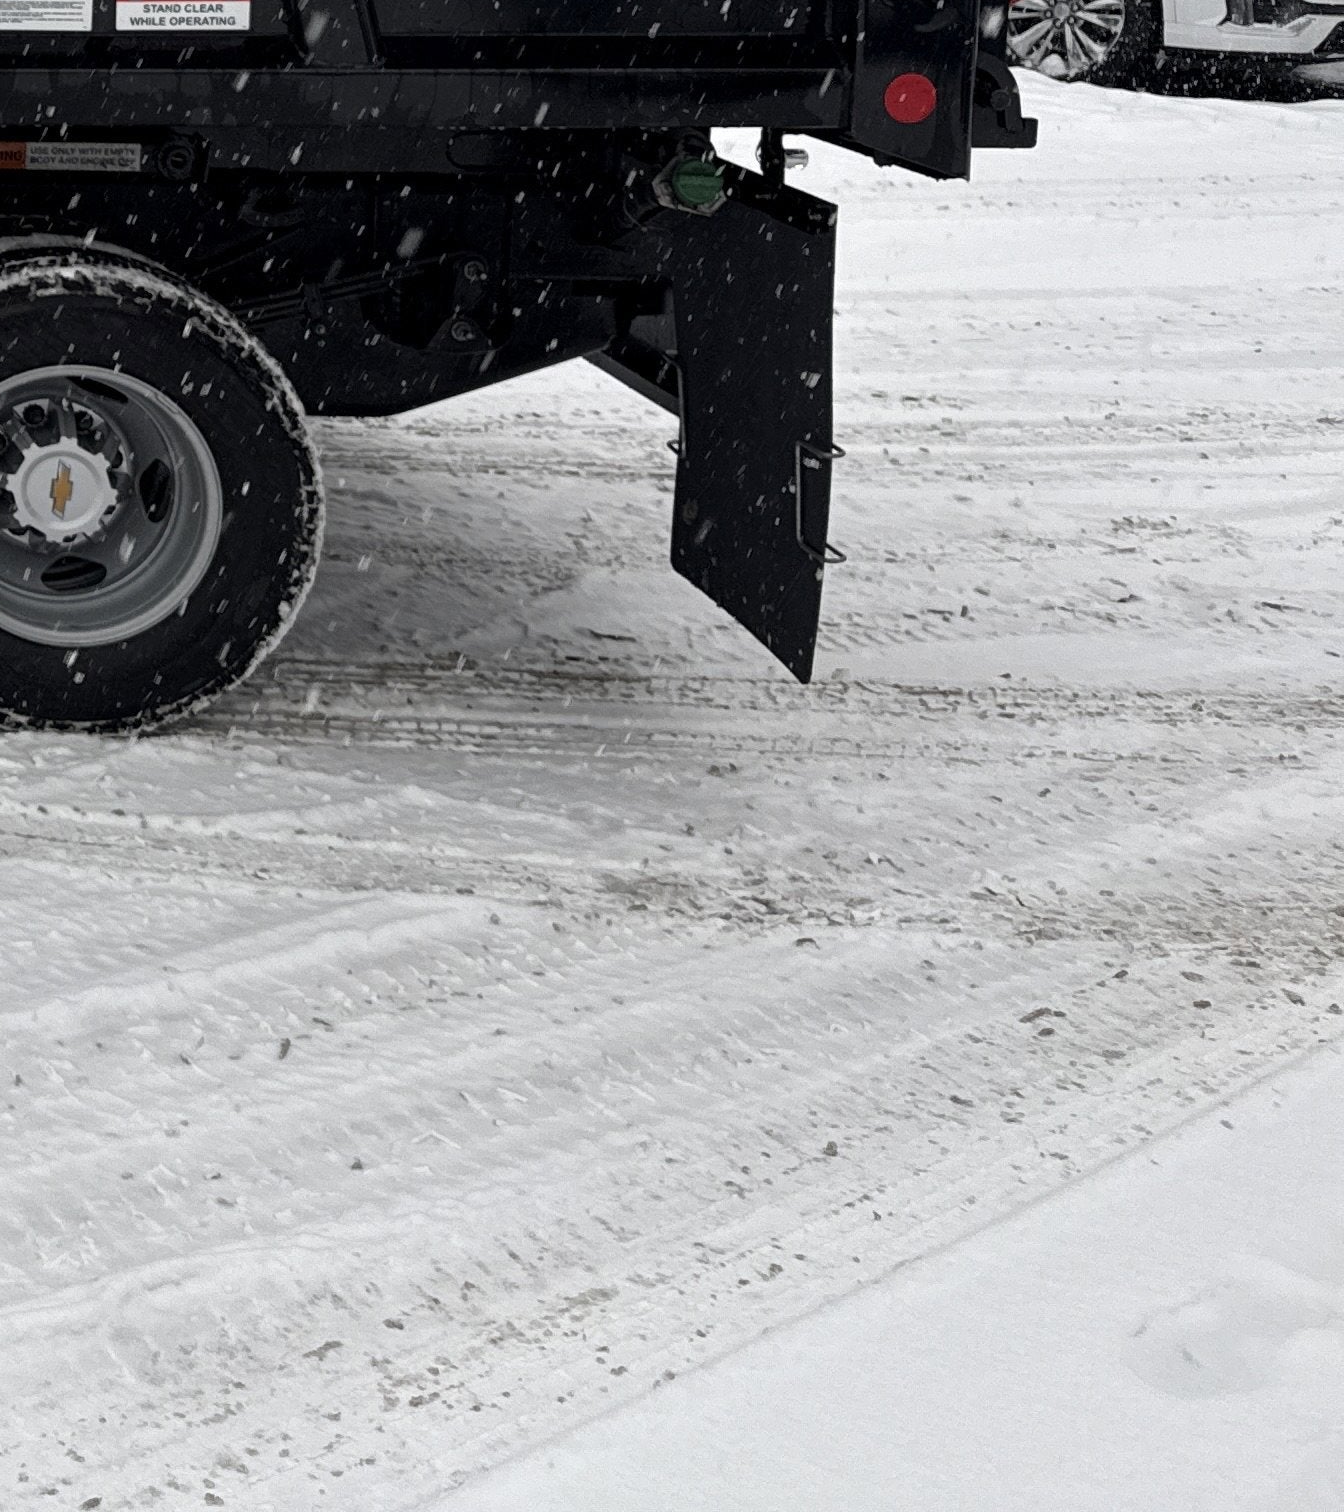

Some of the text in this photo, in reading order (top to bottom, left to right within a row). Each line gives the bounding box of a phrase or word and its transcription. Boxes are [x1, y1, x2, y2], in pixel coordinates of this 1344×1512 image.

[143, 3, 224, 13] STAND CLEAR
[129, 16, 236, 26] WHILE OPERATING
[30, 146, 48, 155] USE
[51, 147, 76, 156] ONLY
[78, 147, 102, 156] WITH
[30, 155, 56, 164] BODY
[59, 156, 78, 164] AND
